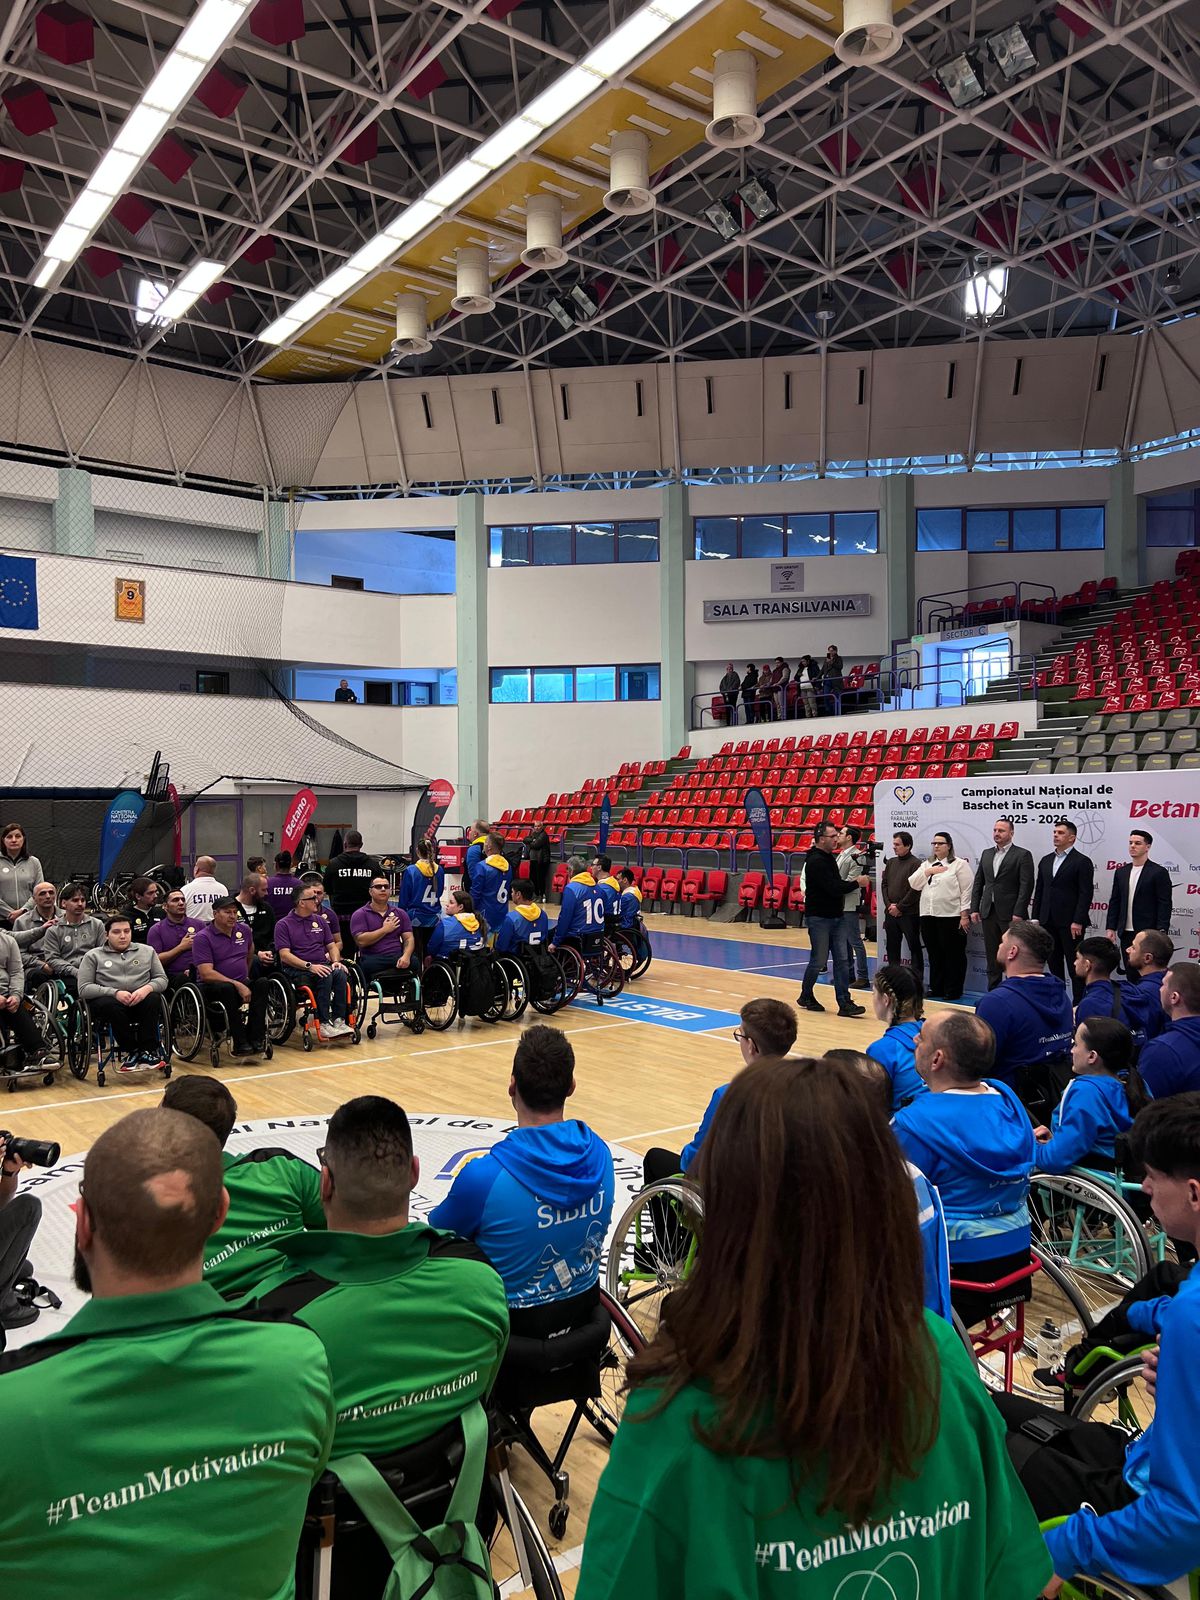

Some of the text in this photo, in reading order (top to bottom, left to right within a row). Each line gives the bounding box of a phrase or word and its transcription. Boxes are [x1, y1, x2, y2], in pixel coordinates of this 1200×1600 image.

[127, 590, 135, 600] 9
[713, 600, 856, 617] SALA TRANSILVANIA
[946, 626, 986, 640] SECTOR C
[961, 784, 1113, 799] Campionatul Național de
[962, 799, 1112, 811] Baschet în Scaun Rulant
[285, 797, 307, 838] Betano
[1001, 814, 1028, 824] 2025
[1038, 813, 1068, 824] 2026
[338, 868, 372, 878] CST ARAD
[273, 887, 284, 895] CST
[422, 884, 438, 906] 4
[497, 880, 508, 904] 6
[193, 893, 206, 904] CST
[582, 897, 605, 925] 10
[447, 1119, 494, 1130] de
[46, 1441, 286, 1526] #TeamMotivation
[754, 1499, 971, 1572] #TeamMotivation
